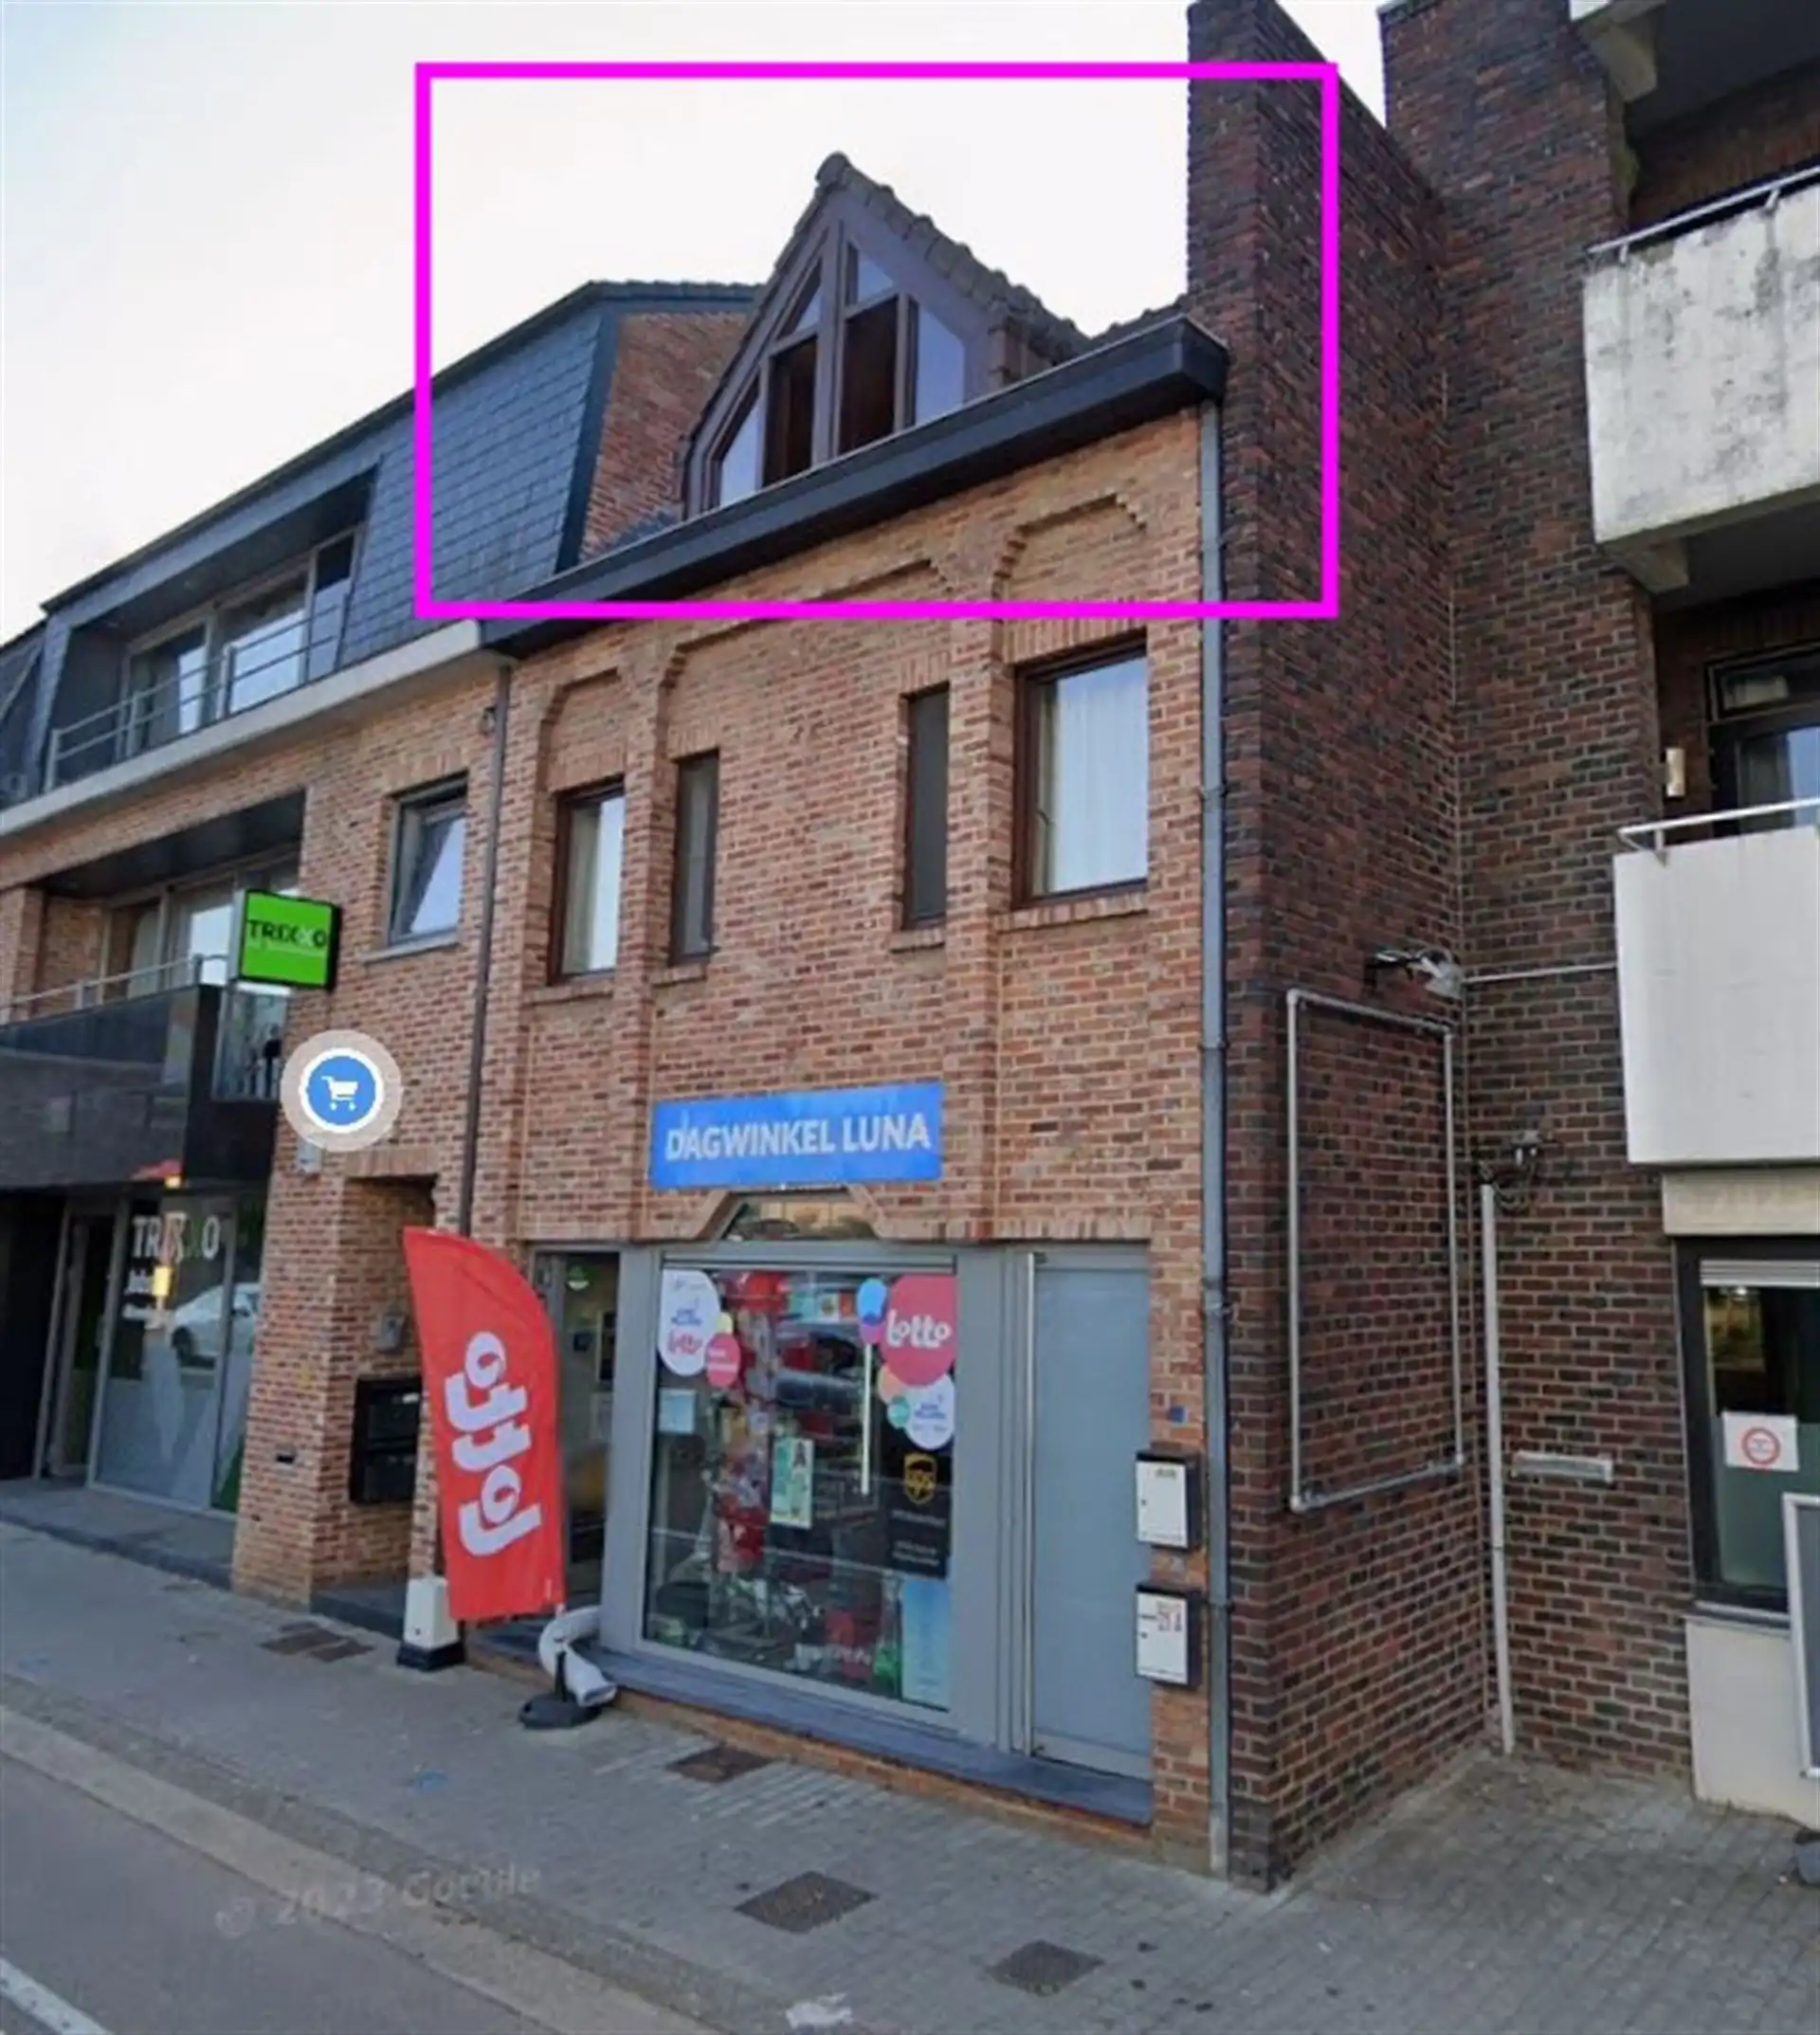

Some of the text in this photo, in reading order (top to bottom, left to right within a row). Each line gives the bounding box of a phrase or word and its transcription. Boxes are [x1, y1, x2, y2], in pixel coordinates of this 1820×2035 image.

[665, 1112, 931, 1161] DAGWINKEL LUNA
[885, 1310, 952, 1349] lotto
[445, 1331, 542, 1556] lotto
